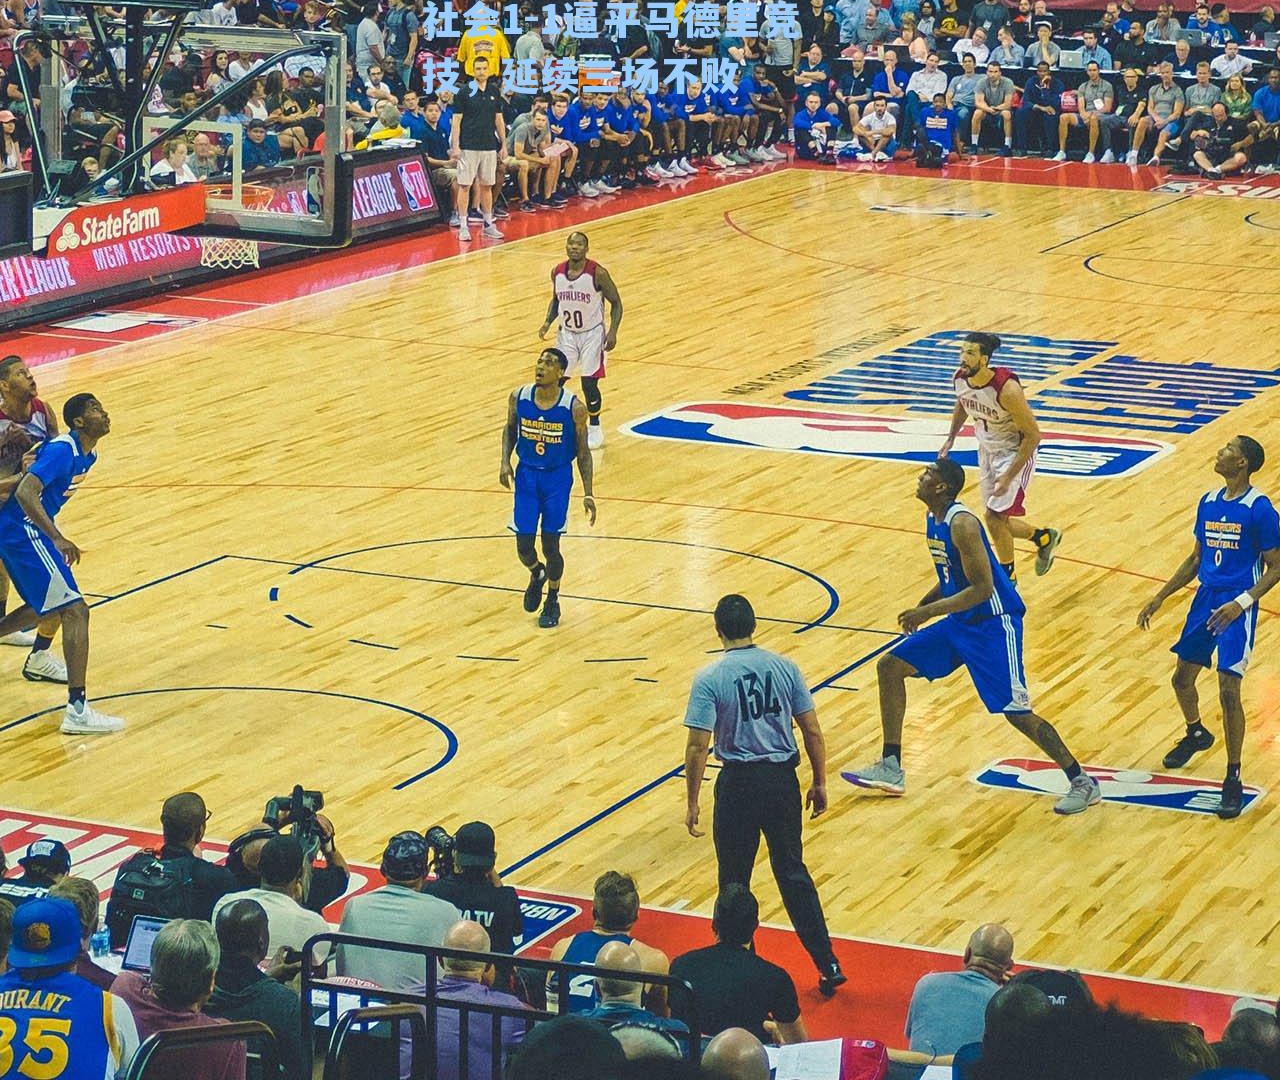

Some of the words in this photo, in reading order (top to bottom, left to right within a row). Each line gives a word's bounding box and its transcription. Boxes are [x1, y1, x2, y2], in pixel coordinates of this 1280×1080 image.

[357, 171, 402, 220] LEAGUE
[410, 169, 429, 201] TV
[93, 244, 129, 271] MGM
[128, 233, 193, 261] RESORTS
[14, 255, 77, 303] LEAGUE
[563, 310, 583, 329] 20
[521, 417, 564, 431] WARRIORS
[535, 441, 545, 455] 6
[1204, 520, 1242, 534] WARRIORS
[1214, 549, 1222, 567] 0
[733, 671, 783, 723] 134
